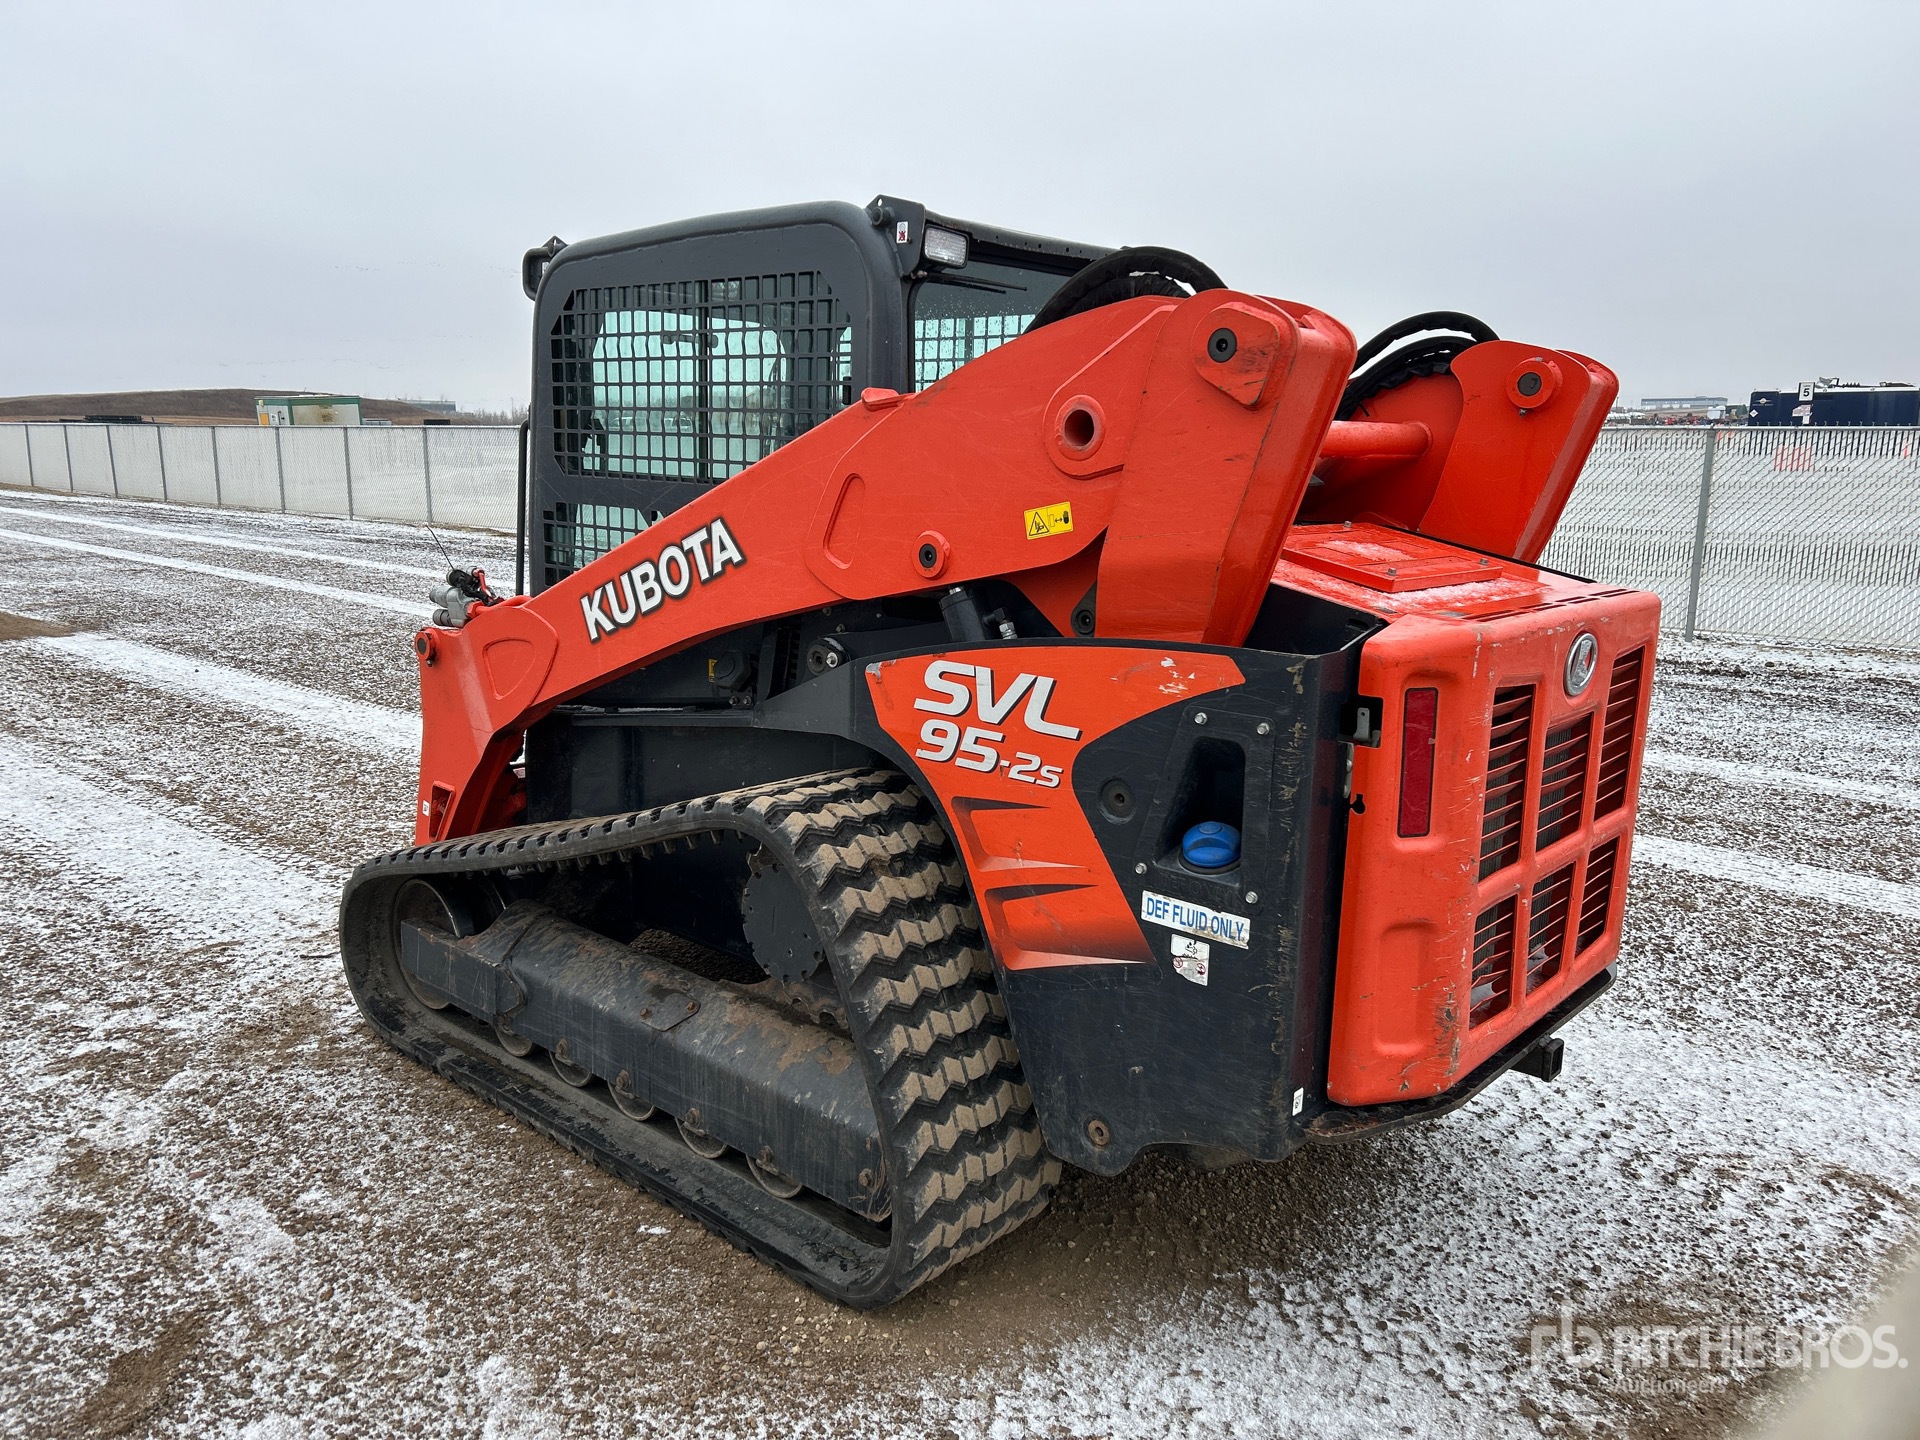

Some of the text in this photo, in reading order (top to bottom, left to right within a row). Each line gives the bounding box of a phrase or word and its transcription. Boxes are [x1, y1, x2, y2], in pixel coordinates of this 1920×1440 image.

[1803, 387, 1810, 397] 5
[579, 517, 746, 642] KUBOTA
[913, 660, 1083, 742] SVL
[1146, 897, 1245, 941] DEF FLUID ONLY
